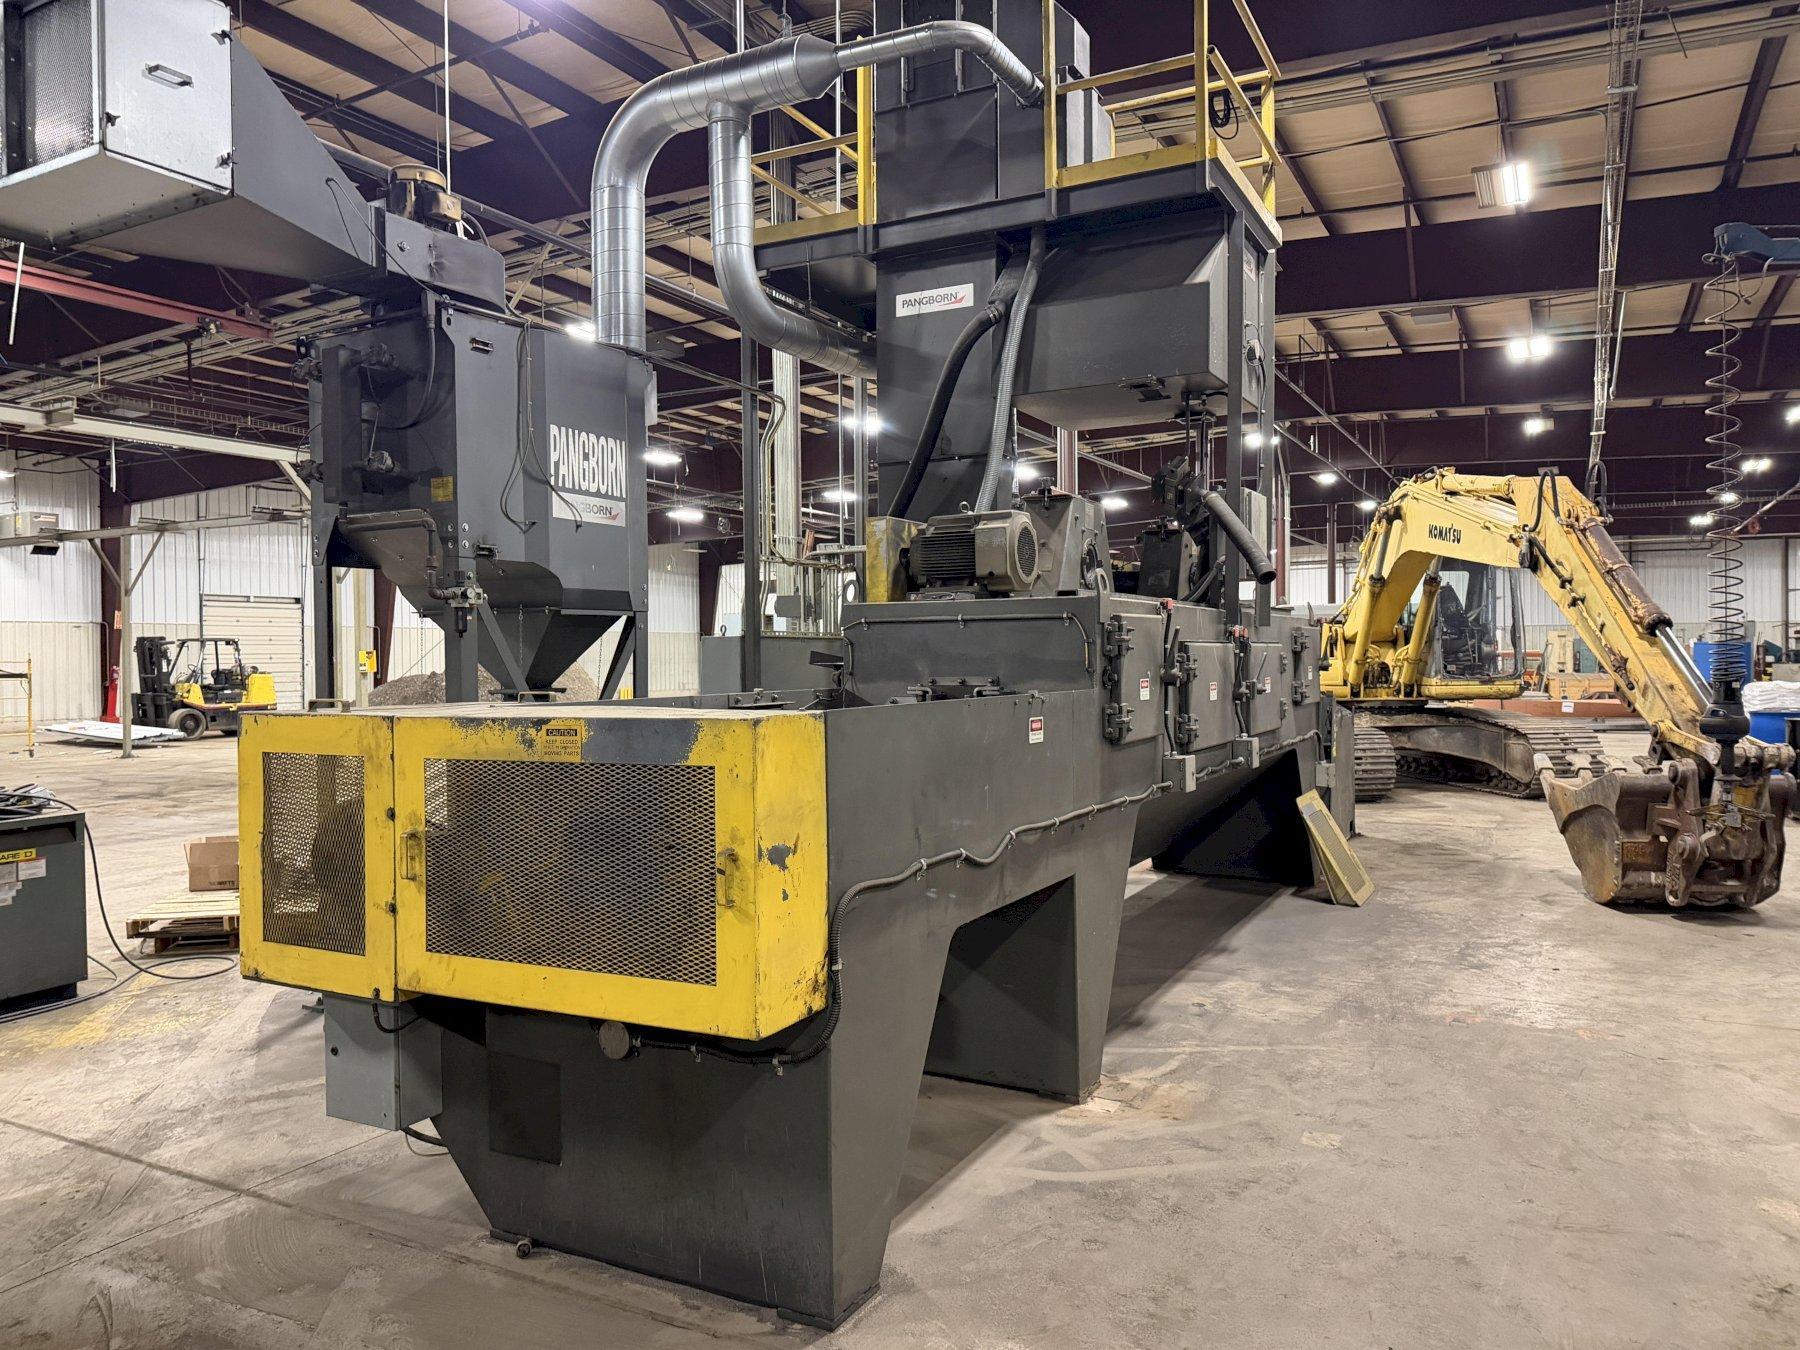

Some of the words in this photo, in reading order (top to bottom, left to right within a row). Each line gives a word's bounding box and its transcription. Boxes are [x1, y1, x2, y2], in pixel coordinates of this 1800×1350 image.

[902, 291, 959, 309] PANGBORN
[550, 424, 626, 498] PANGBORN
[1428, 523, 1462, 545] KOMATSU
[24, 850, 33, 858] D
